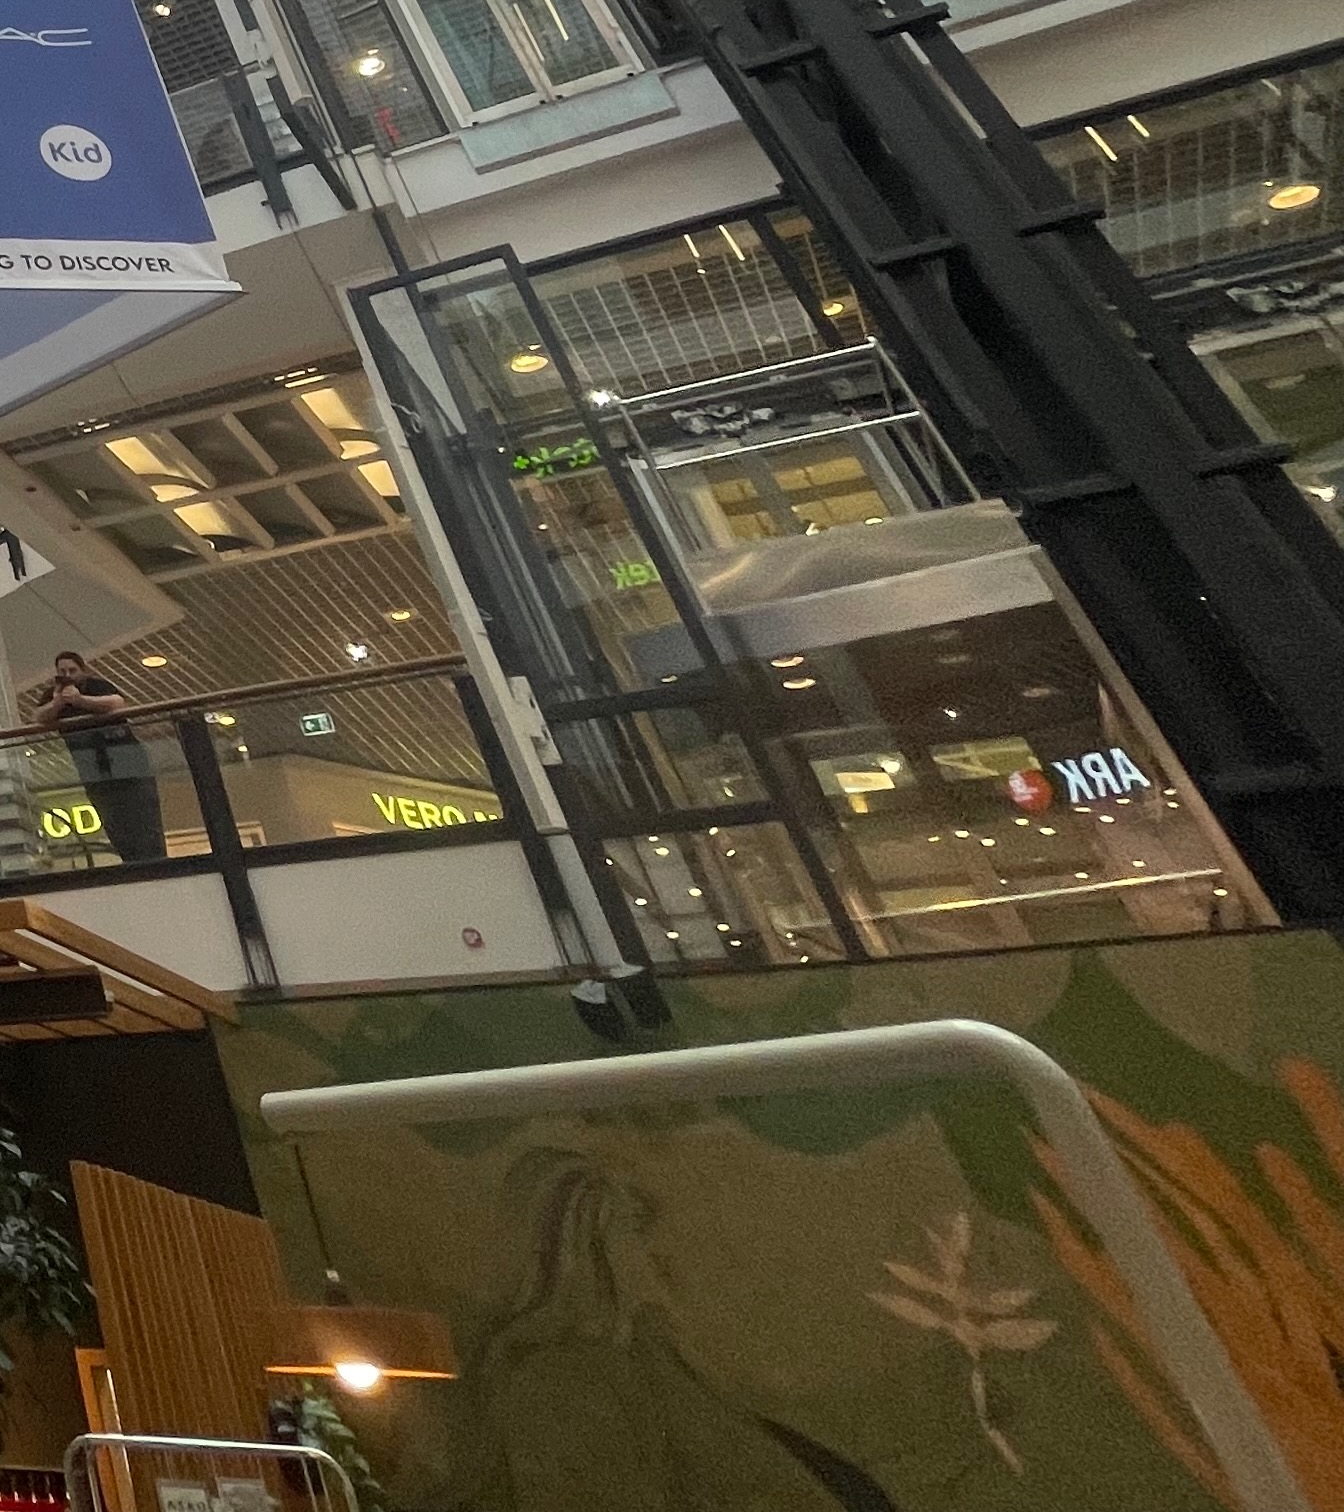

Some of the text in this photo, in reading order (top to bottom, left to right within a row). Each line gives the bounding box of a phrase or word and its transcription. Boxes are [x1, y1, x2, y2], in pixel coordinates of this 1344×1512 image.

[48, 141, 103, 164] Kid
[21, 253, 53, 272] TO
[59, 254, 175, 274] DISCOVER
[371, 792, 468, 831] VERO
